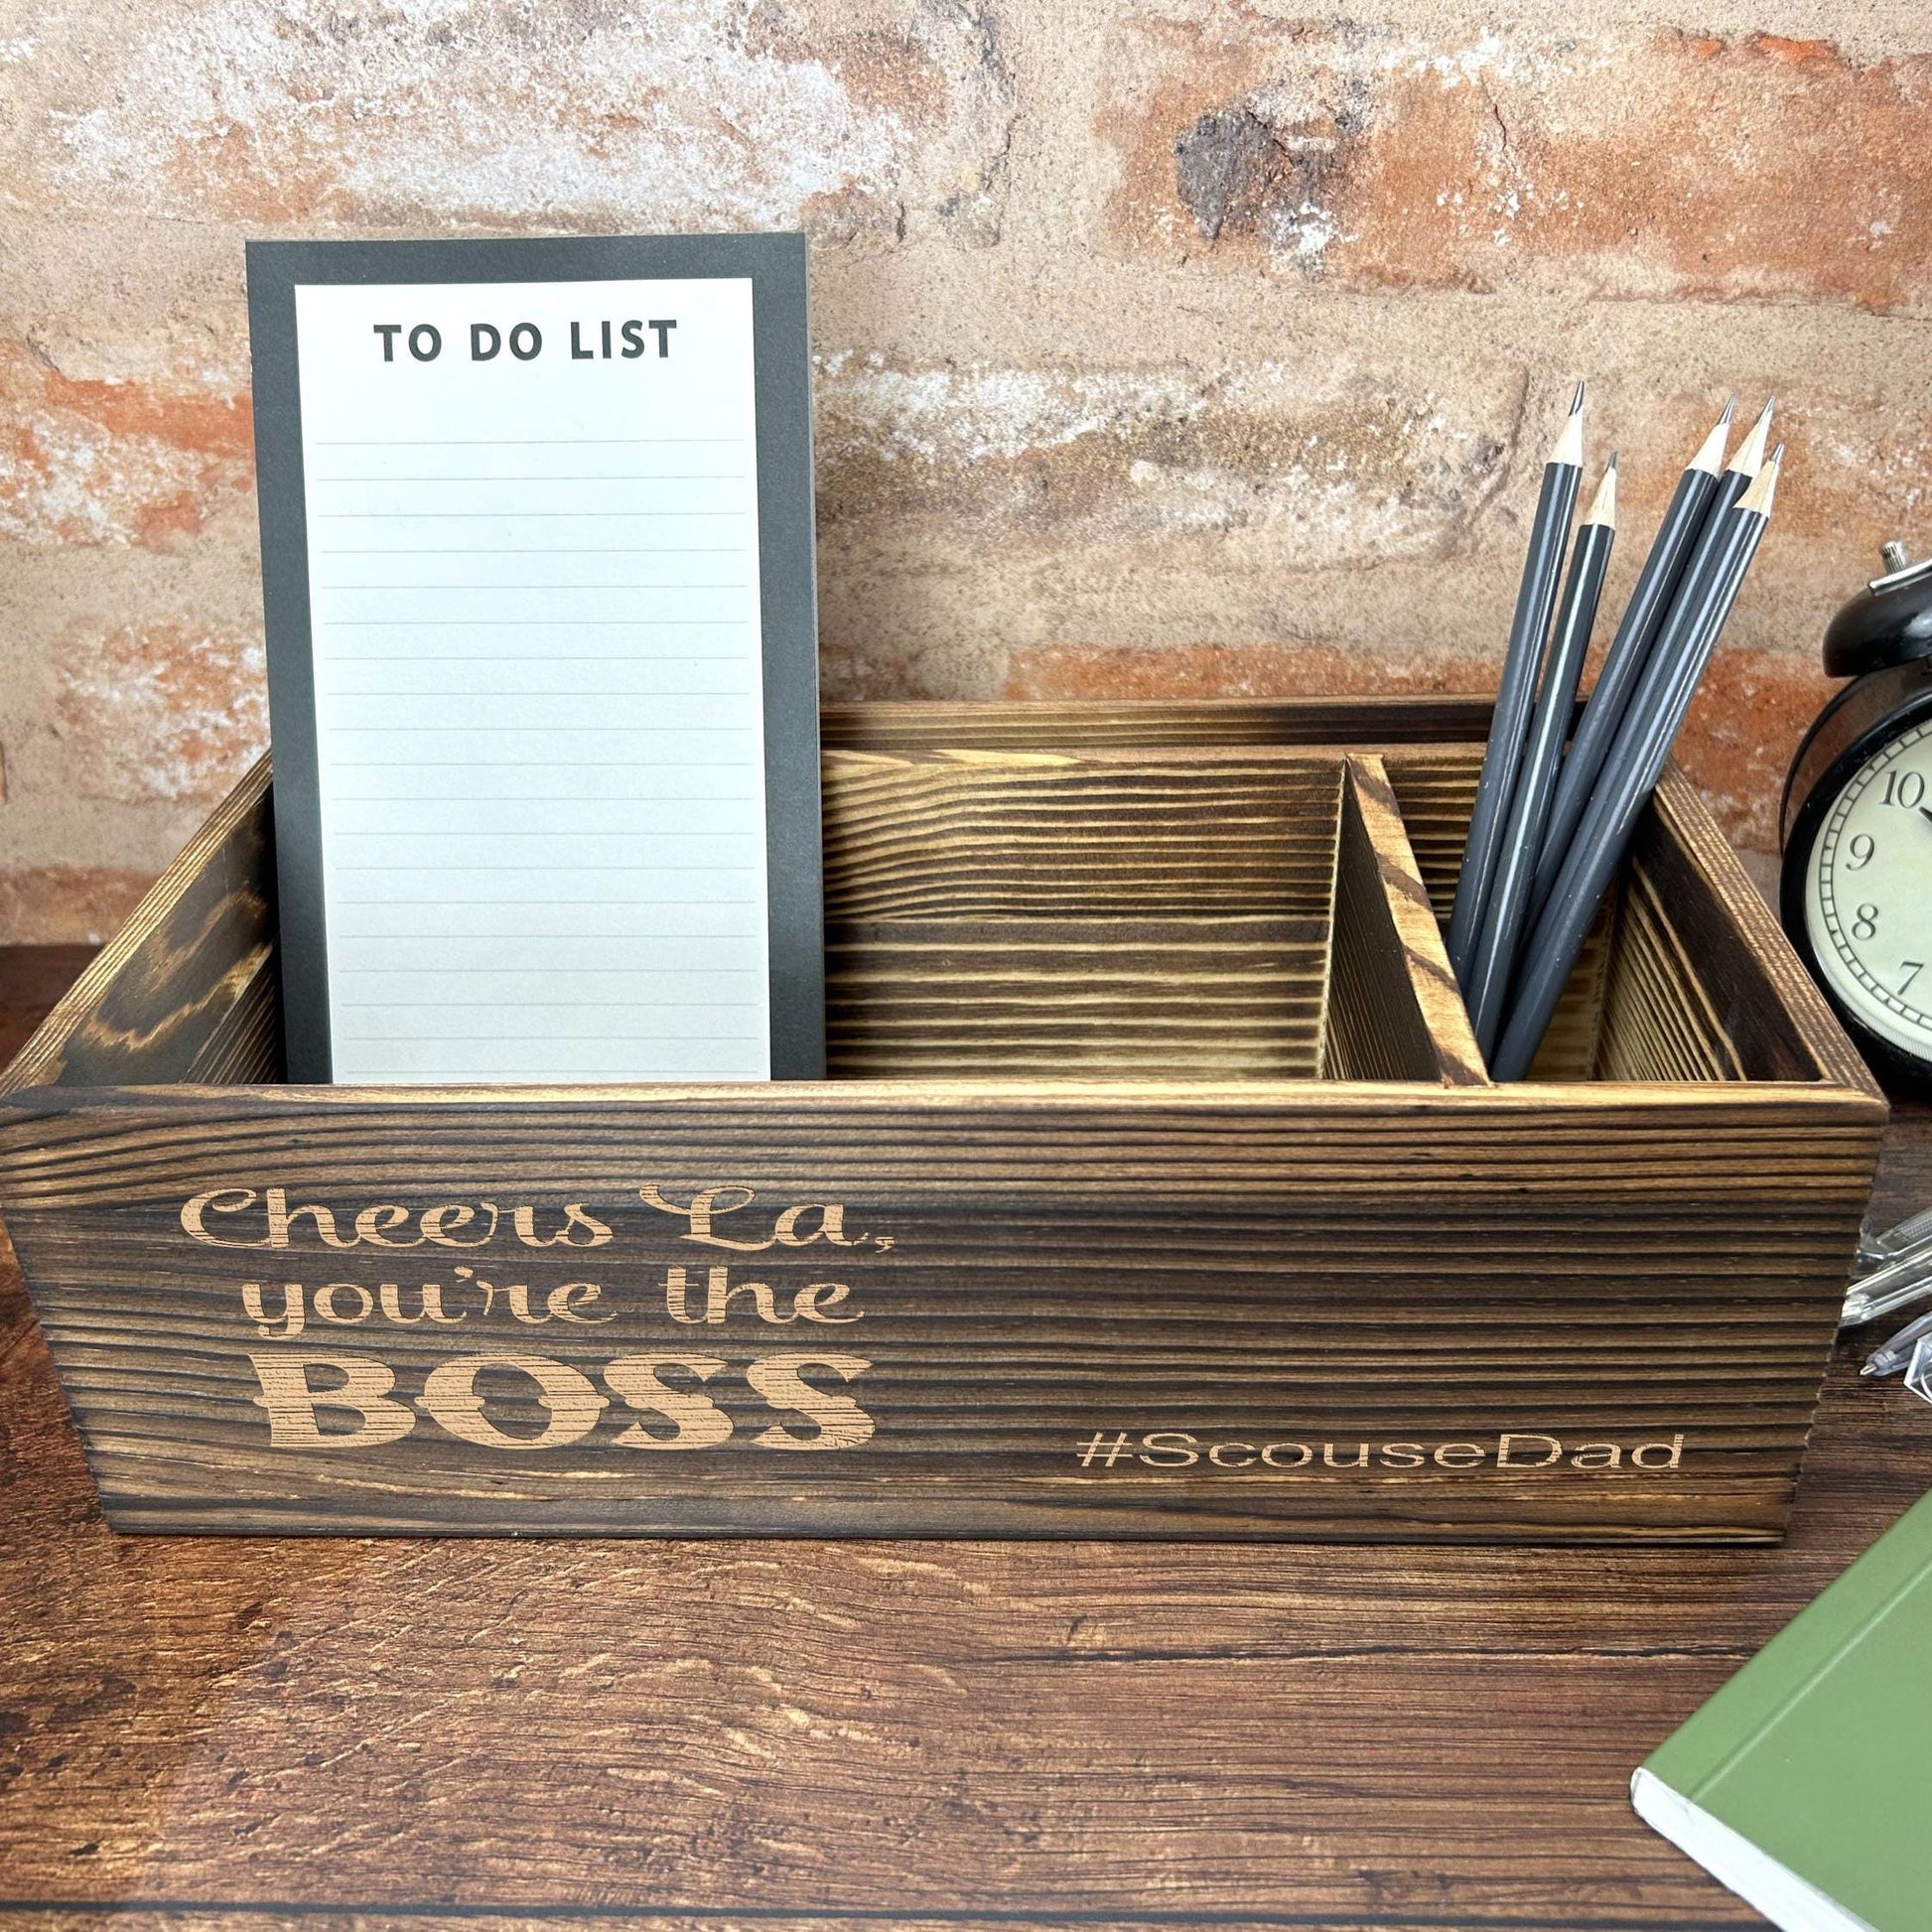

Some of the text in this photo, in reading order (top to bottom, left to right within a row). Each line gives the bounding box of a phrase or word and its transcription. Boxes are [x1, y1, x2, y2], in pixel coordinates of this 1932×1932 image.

[373, 320, 677, 362] TO DO LIST
[1879, 769, 1926, 810] 10
[1846, 833, 1875, 871] 9
[1852, 903, 1879, 941] 8
[1897, 961, 1925, 996] 7
[180, 1187, 614, 1248] Cheers
[241, 1265, 867, 1341] you're the
[247, 1351, 877, 1451] BOSS
[1076, 1432, 1685, 1470] #ScouseDad
